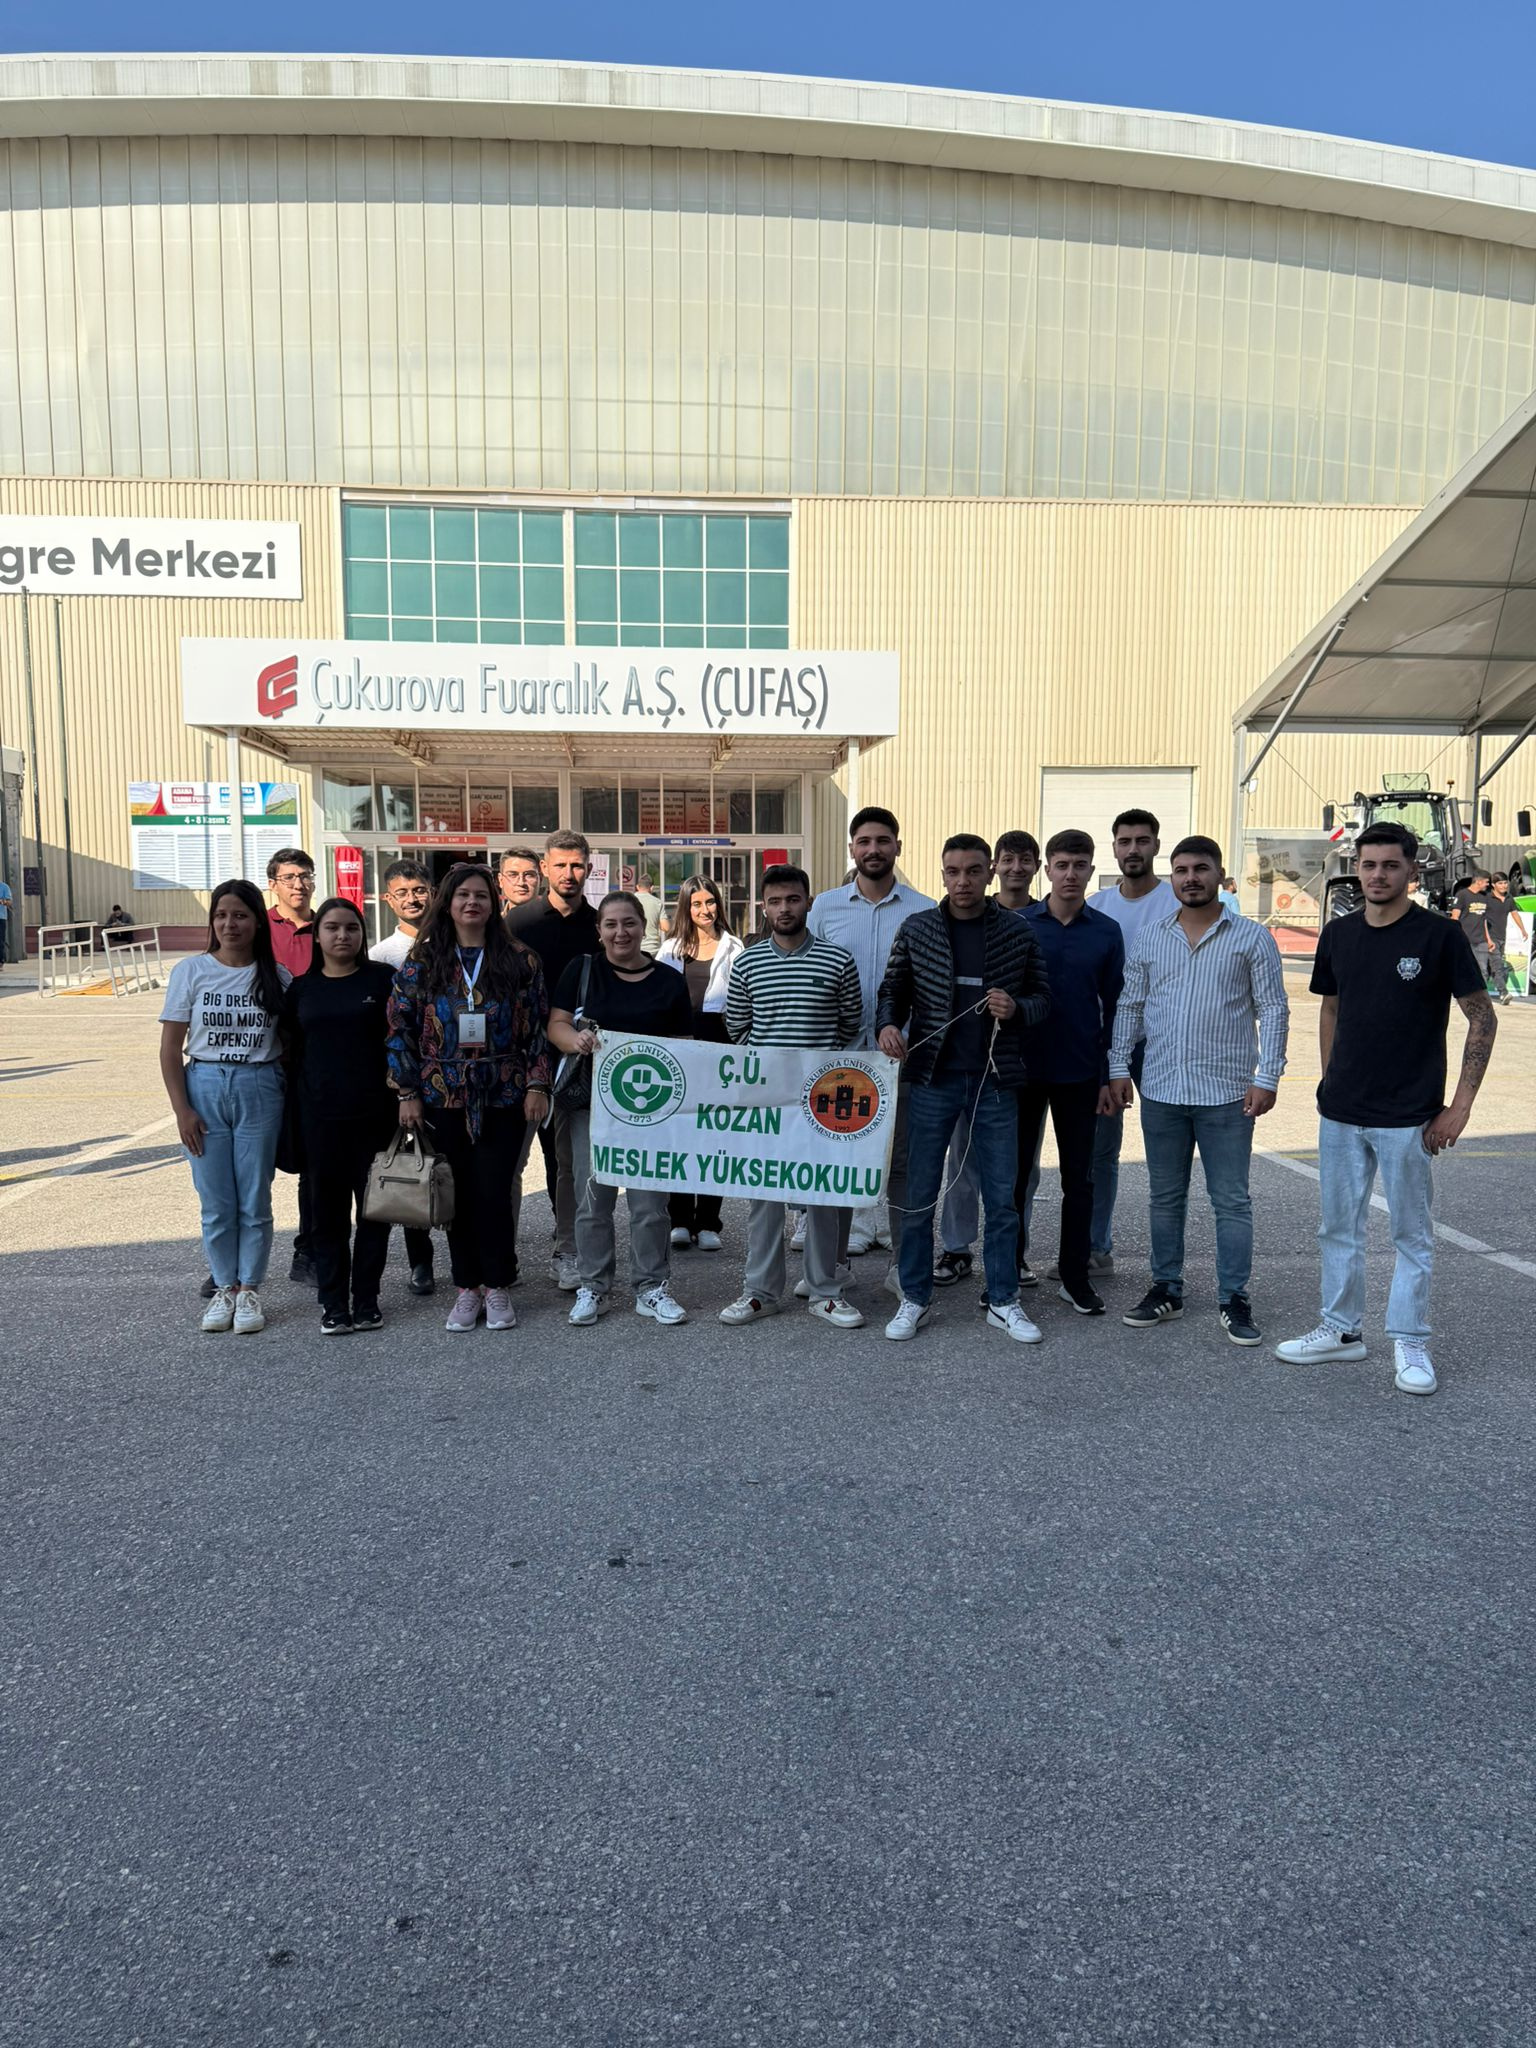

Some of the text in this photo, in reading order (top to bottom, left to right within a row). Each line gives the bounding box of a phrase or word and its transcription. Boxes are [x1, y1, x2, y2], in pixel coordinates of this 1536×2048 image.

[92, 537, 276, 579] Merkezi
[311, 656, 829, 730] Çukurova Fuarcılık A.Ş. (ÇUFAŞ)
[203, 992, 256, 1007] BIG DREA
[202, 1011, 272, 1028] GOOD MUSIC
[207, 1031, 265, 1048] EXPENSIVE
[601, 1046, 634, 1093] ÇUKUROVA
[718, 1051, 767, 1088] Ç.Ü.
[803, 1060, 842, 1092] ÇUKUROVA
[628, 1114, 652, 1123] 1973
[696, 1103, 782, 1136] KOZAN
[801, 1099, 817, 1126] KOZAN
[815, 1124, 843, 1141] MESLEK
[593, 1144, 882, 1197] MESLEK YÜKSEKOKULU
